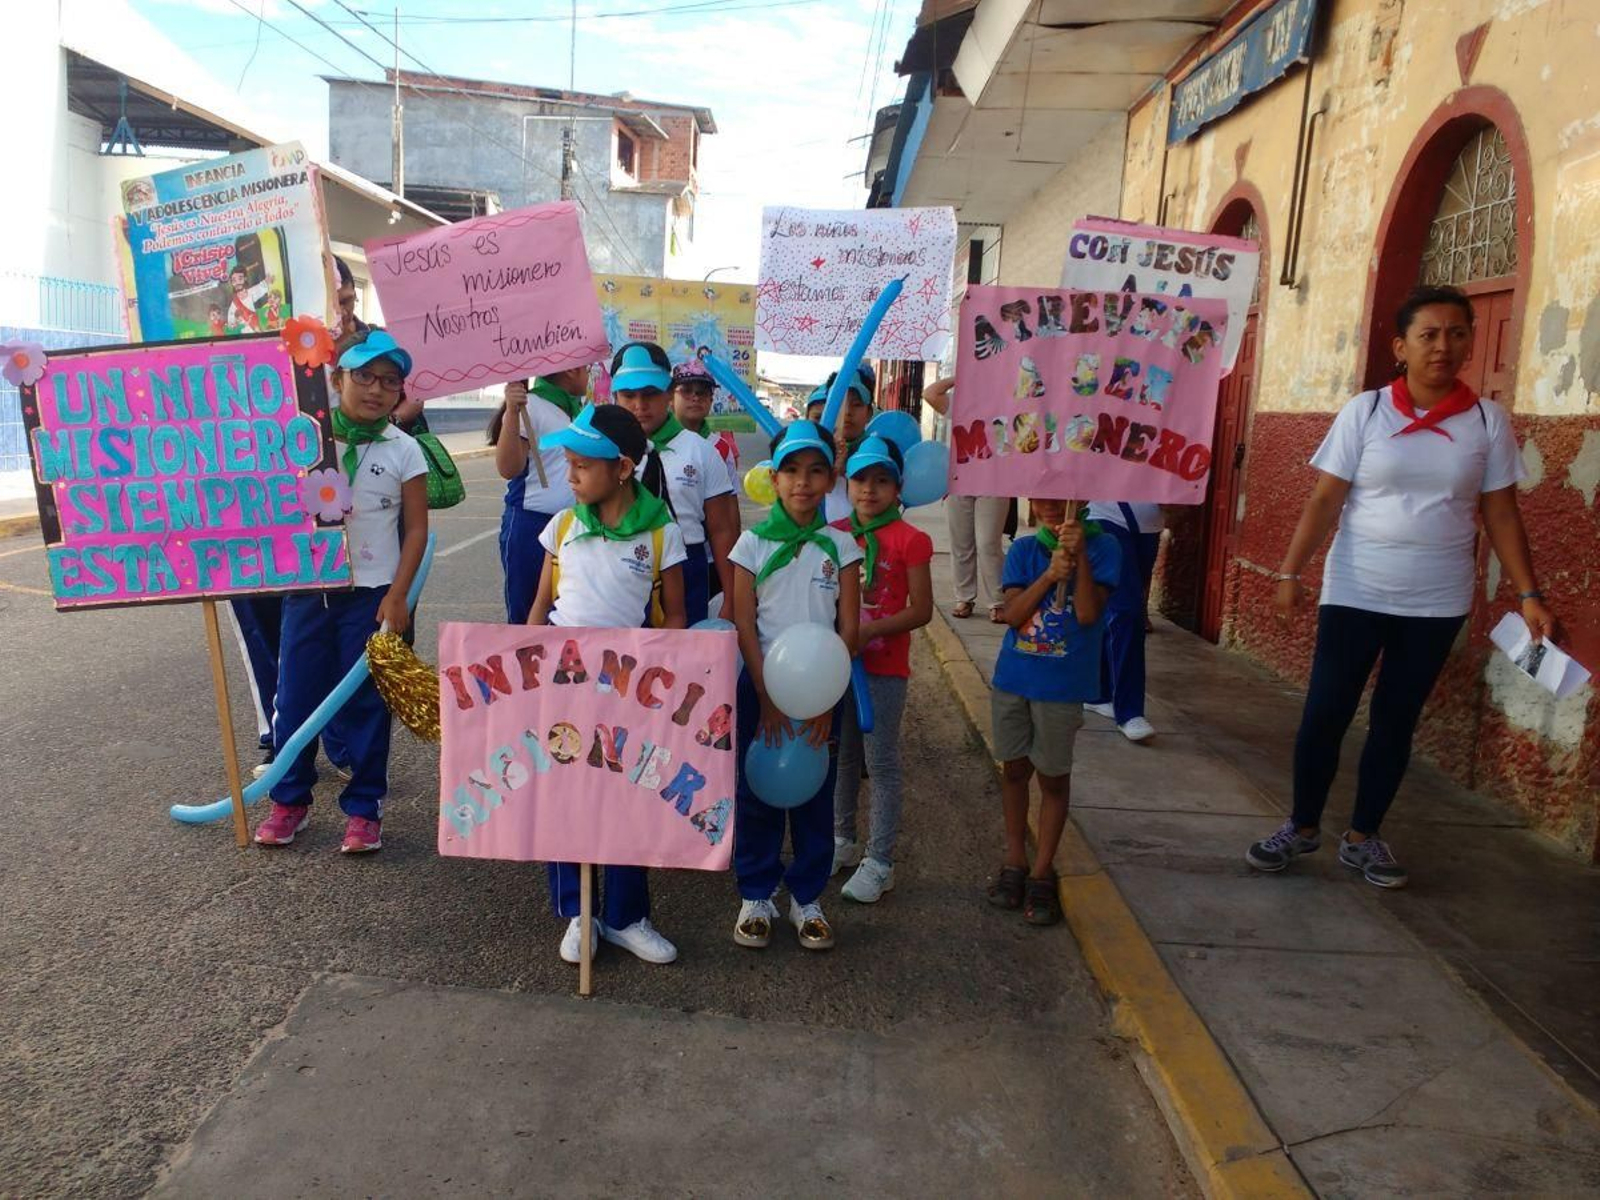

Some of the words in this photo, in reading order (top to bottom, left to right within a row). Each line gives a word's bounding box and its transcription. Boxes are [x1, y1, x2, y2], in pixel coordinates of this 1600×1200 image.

[133, 209, 147, 225] Y
[148, 188, 238, 221] ADOLESCENCIA
[240, 171, 309, 198] MISIONERA
[185, 162, 246, 188] INFANCIA
[144, 233, 194, 253] Podemos
[255, 218, 263, 227] a
[186, 217, 197, 228] es
[200, 207, 244, 226] Nuestra
[246, 195, 289, 215] Alegría,
[769, 210, 807, 239] Los
[814, 220, 858, 239] niños
[384, 240, 451, 276] Jesús
[473, 231, 500, 256] es
[1068, 232, 1132, 265] CON
[462, 261, 562, 294] misionero
[423, 298, 499, 344] Nosotros
[732, 349, 750, 361] 26
[52, 367, 132, 426] UN
[148, 353, 284, 422] NIÑO
[1013, 354, 1046, 400] A
[1071, 352, 1174, 412] SER
[34, 414, 322, 483] MISIONERO
[951, 411, 1212, 482] MISIONERO
[66, 474, 305, 534] SIEMPRE
[188, 529, 350, 590] FELIZ
[442, 638, 734, 751] INFANCIA
[442, 720, 734, 847] MISIONERA
